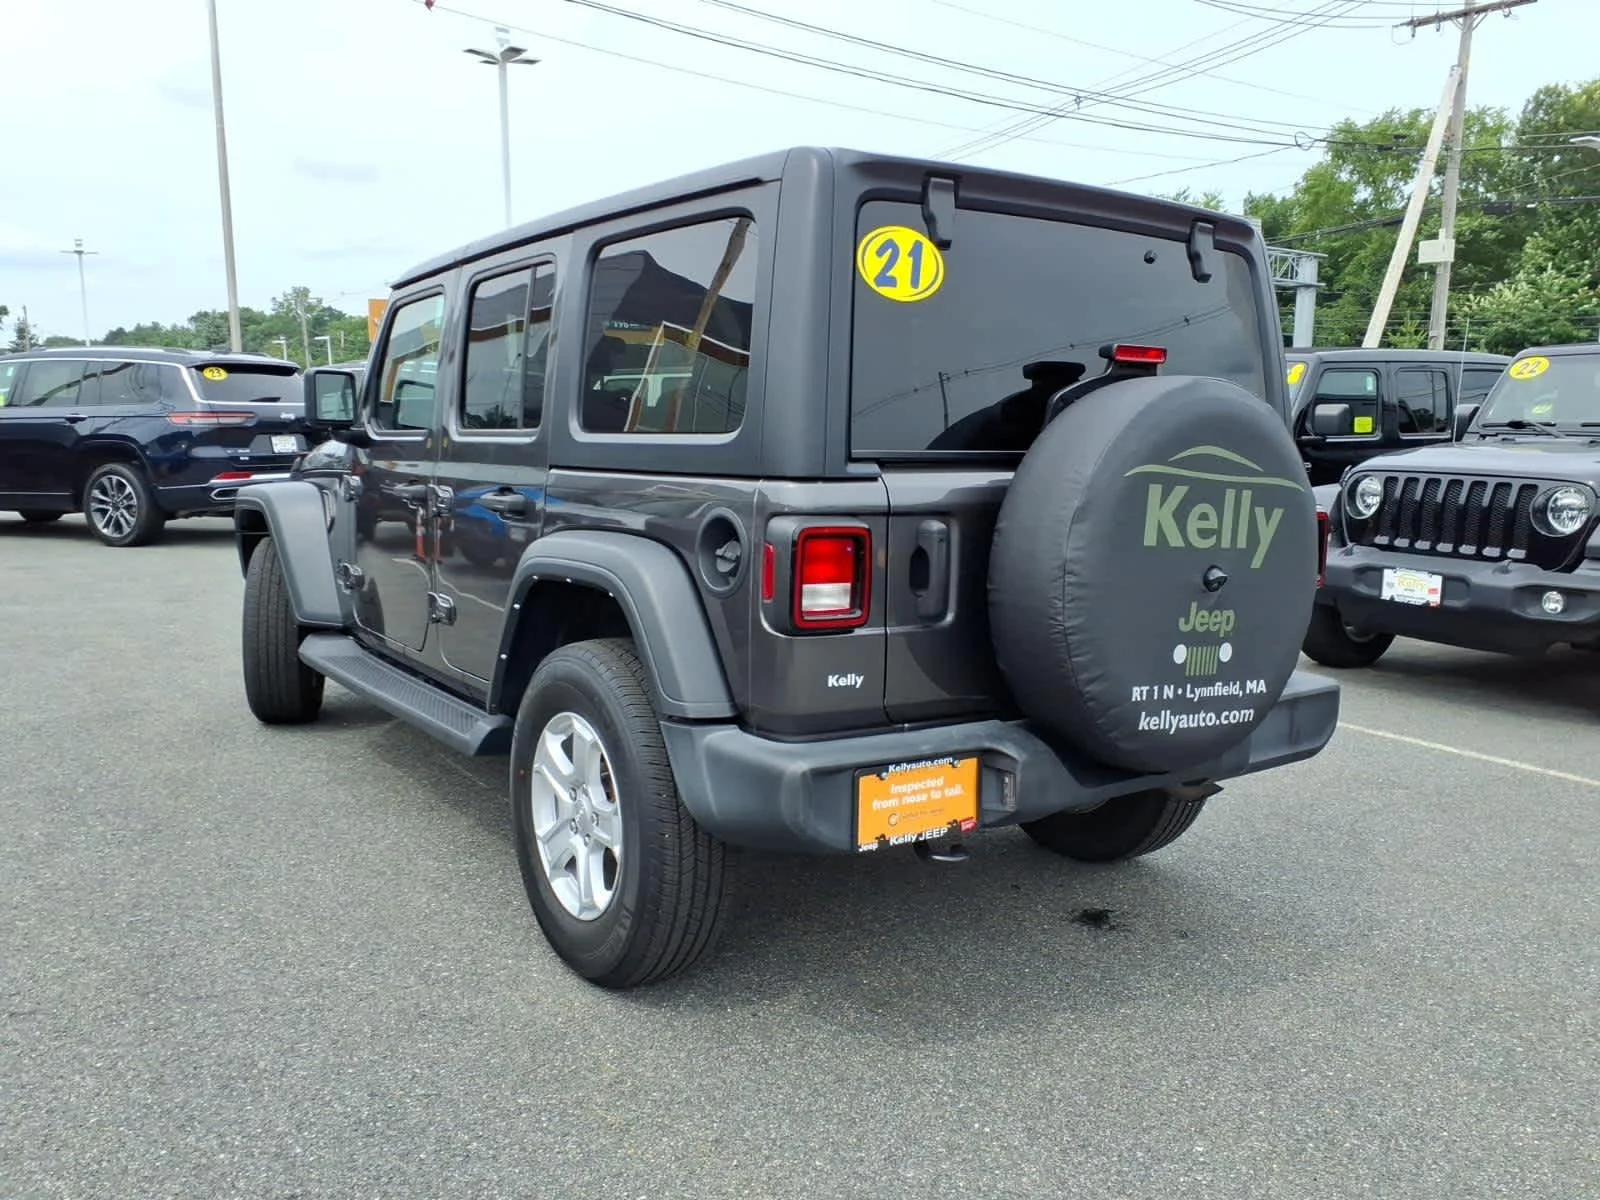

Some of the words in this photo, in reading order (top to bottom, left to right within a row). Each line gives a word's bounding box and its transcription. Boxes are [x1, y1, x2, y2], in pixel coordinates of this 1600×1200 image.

[873, 238, 923, 289] 21
[1143, 483, 1285, 569] Kelly
[1178, 601, 1236, 638] Jeep
[827, 673, 864, 689] Kelly
[1131, 685, 1149, 702] RT
[1152, 685, 1159, 700] 1
[1163, 684, 1174, 700] N
[1186, 680, 1243, 702] Lynnfield,
[1245, 679, 1267, 694] MA
[1138, 708, 1255, 735] kellyauto.com
[888, 757, 953, 773] Kellyauto.com
[872, 798, 899, 811] from
[930, 789, 942, 799] to
[889, 832, 917, 846] Kelly
[918, 827, 948, 841] JEEP
